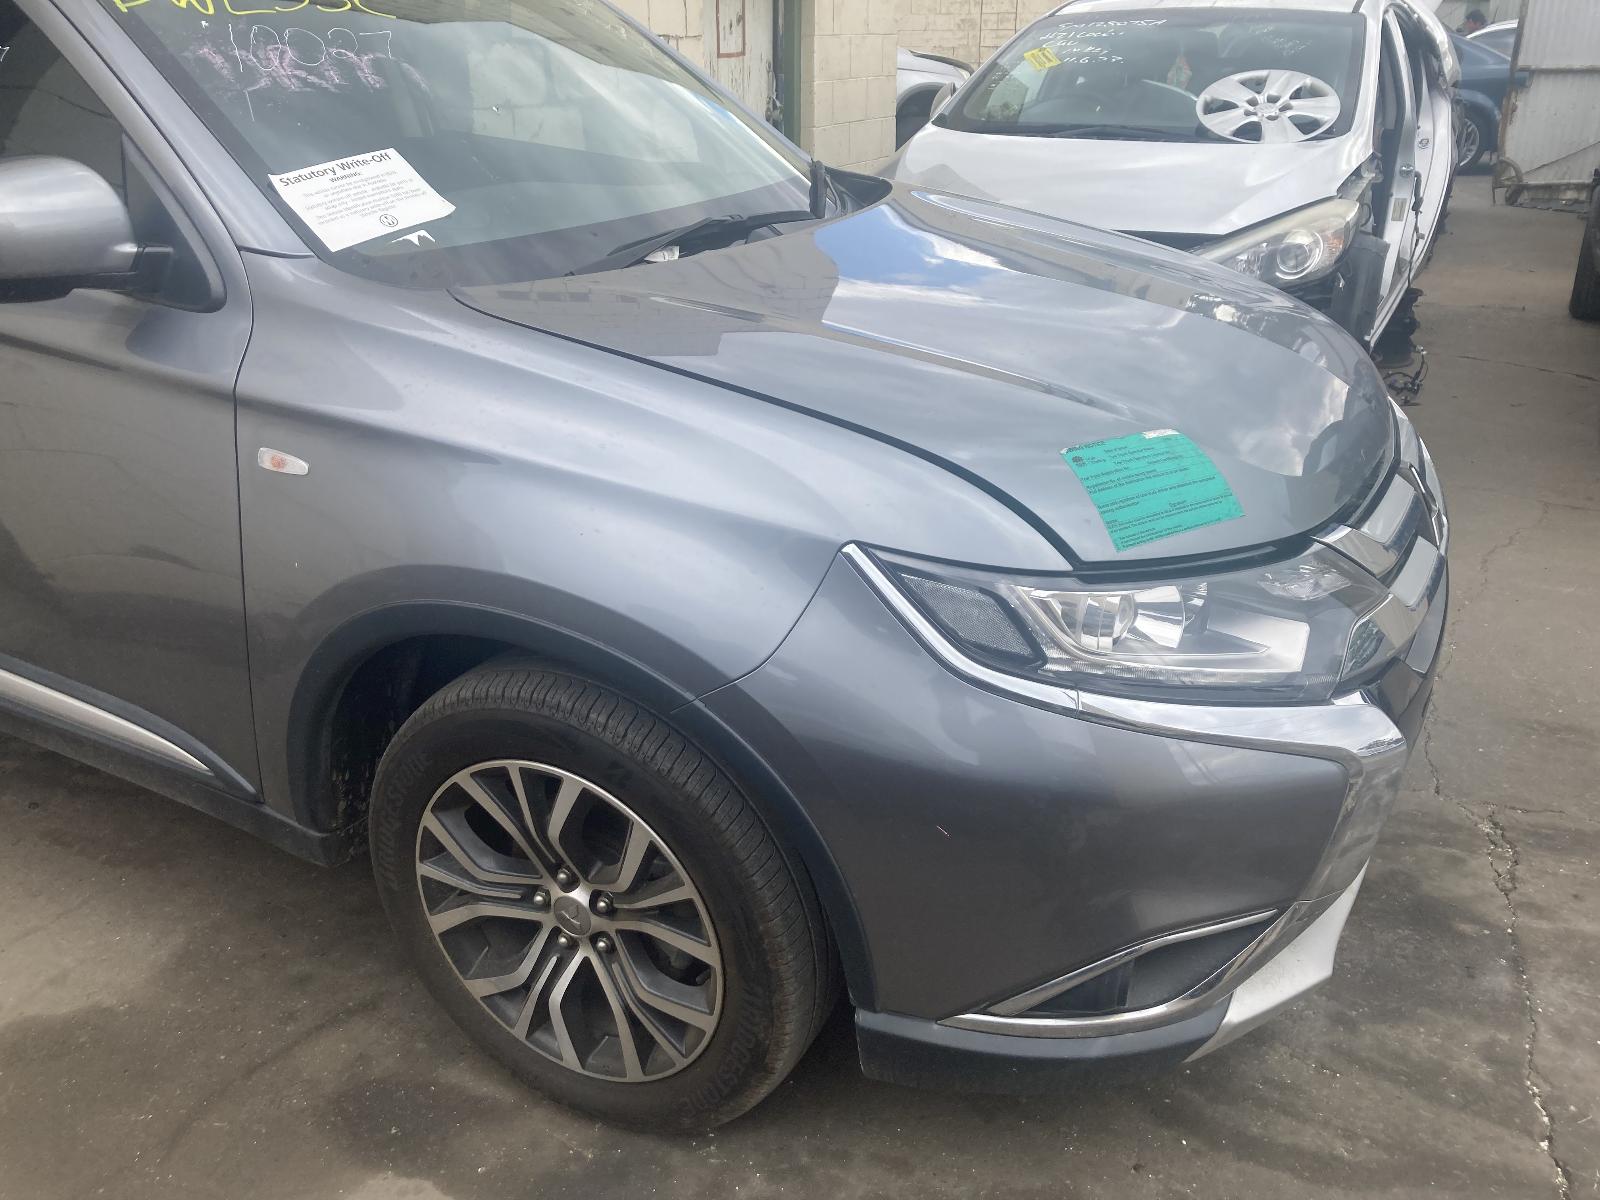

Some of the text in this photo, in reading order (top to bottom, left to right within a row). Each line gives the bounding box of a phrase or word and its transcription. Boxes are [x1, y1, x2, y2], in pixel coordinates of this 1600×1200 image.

[229, 23, 393, 73] 10027
[279, 165, 338, 187] Statutory
[337, 152, 393, 172] Write-Off
